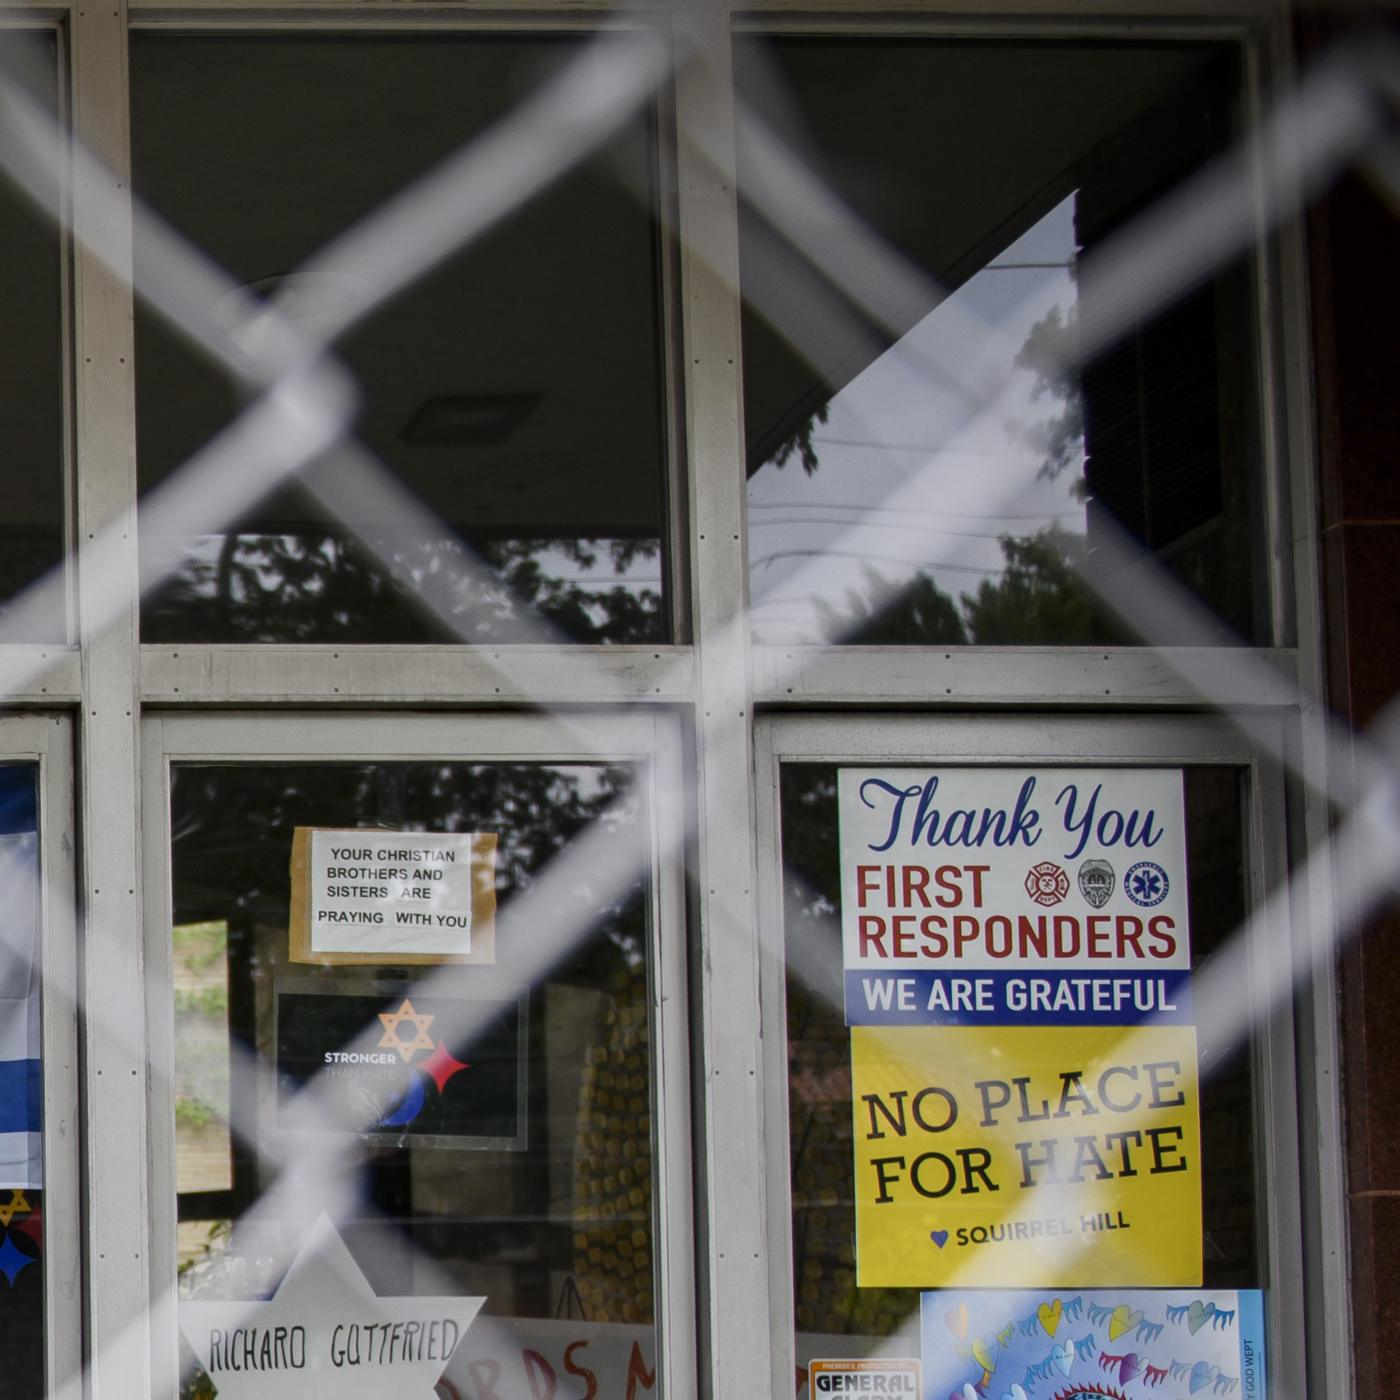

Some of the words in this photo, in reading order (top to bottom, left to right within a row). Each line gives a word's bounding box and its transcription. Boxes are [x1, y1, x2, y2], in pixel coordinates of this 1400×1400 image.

[859, 776, 1043, 853] Thank
[1054, 784, 1164, 859] You
[331, 849, 373, 861] YOUR
[377, 849, 455, 862] CHRISTIAN
[327, 868, 408, 880] BROTHERS
[413, 868, 443, 880] AND
[856, 865, 990, 908] FIRST
[327, 886, 388, 898] SISTERS
[401, 887, 431, 899] ARE
[318, 911, 384, 924] PRAYING
[396, 911, 433, 925] WITH
[436, 915, 467, 928] YOU
[858, 915, 1176, 960] RESPONDERS
[862, 979, 916, 1011] WE
[927, 979, 994, 1011] ARE
[1006, 979, 1176, 1011] GRATEFUL
[860, 1087, 958, 1140] NO
[975, 1061, 1185, 1127] PLACE
[870, 1148, 999, 1204] FOR
[1015, 1126, 1188, 1188] HATE
[956, 1218, 1073, 1247] SQUIRREL
[1081, 1212, 1130, 1232] HILL
[210, 1326, 305, 1372] RICHARD
[331, 1319, 459, 1367] GOTTFRIED
[1243, 1339, 1253, 1366] WEPT
[1245, 1369, 1254, 1391] GOD
